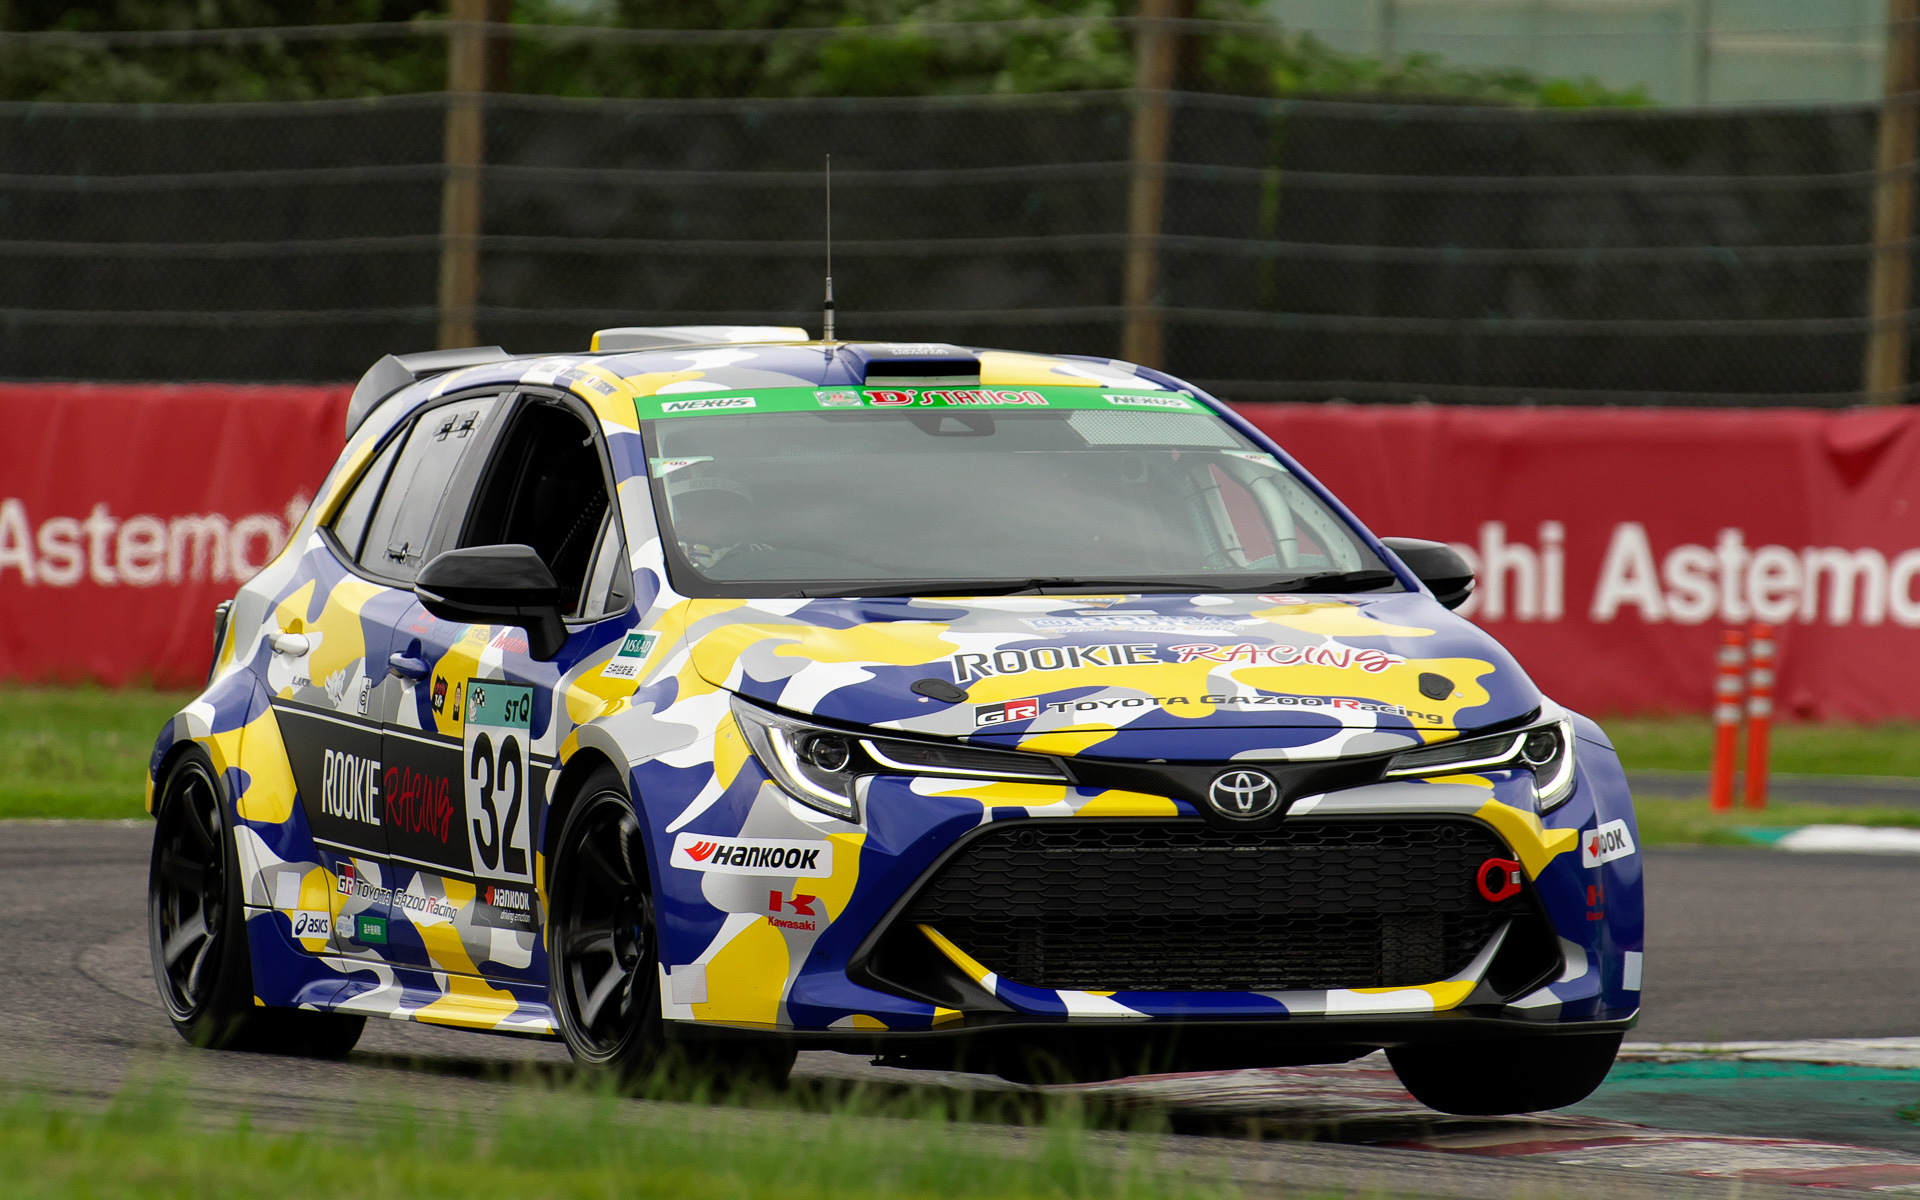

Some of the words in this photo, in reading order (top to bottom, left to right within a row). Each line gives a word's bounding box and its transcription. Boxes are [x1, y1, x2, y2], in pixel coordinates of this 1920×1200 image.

[667, 398, 749, 411] NEXUS
[1114, 394, 1183, 406] NEXUS
[623, 639, 652, 653] MS&AD
[954, 643, 1161, 683] ROOKIE
[1169, 643, 1405, 672] RACING
[505, 693, 530, 722] STQ
[976, 703, 1037, 726] GR
[1048, 697, 1190, 713] TOYOTA
[1333, 698, 1444, 725] Racing
[321, 748, 381, 826] ROOKIE
[384, 765, 454, 844] RACING
[471, 732, 528, 876] 32
[337, 874, 355, 896] GR
[356, 878, 392, 905] TOYOTA
[426, 896, 457, 924] Racing
[307, 917, 328, 934] asics
[768, 915, 816, 931] Kawasaki
